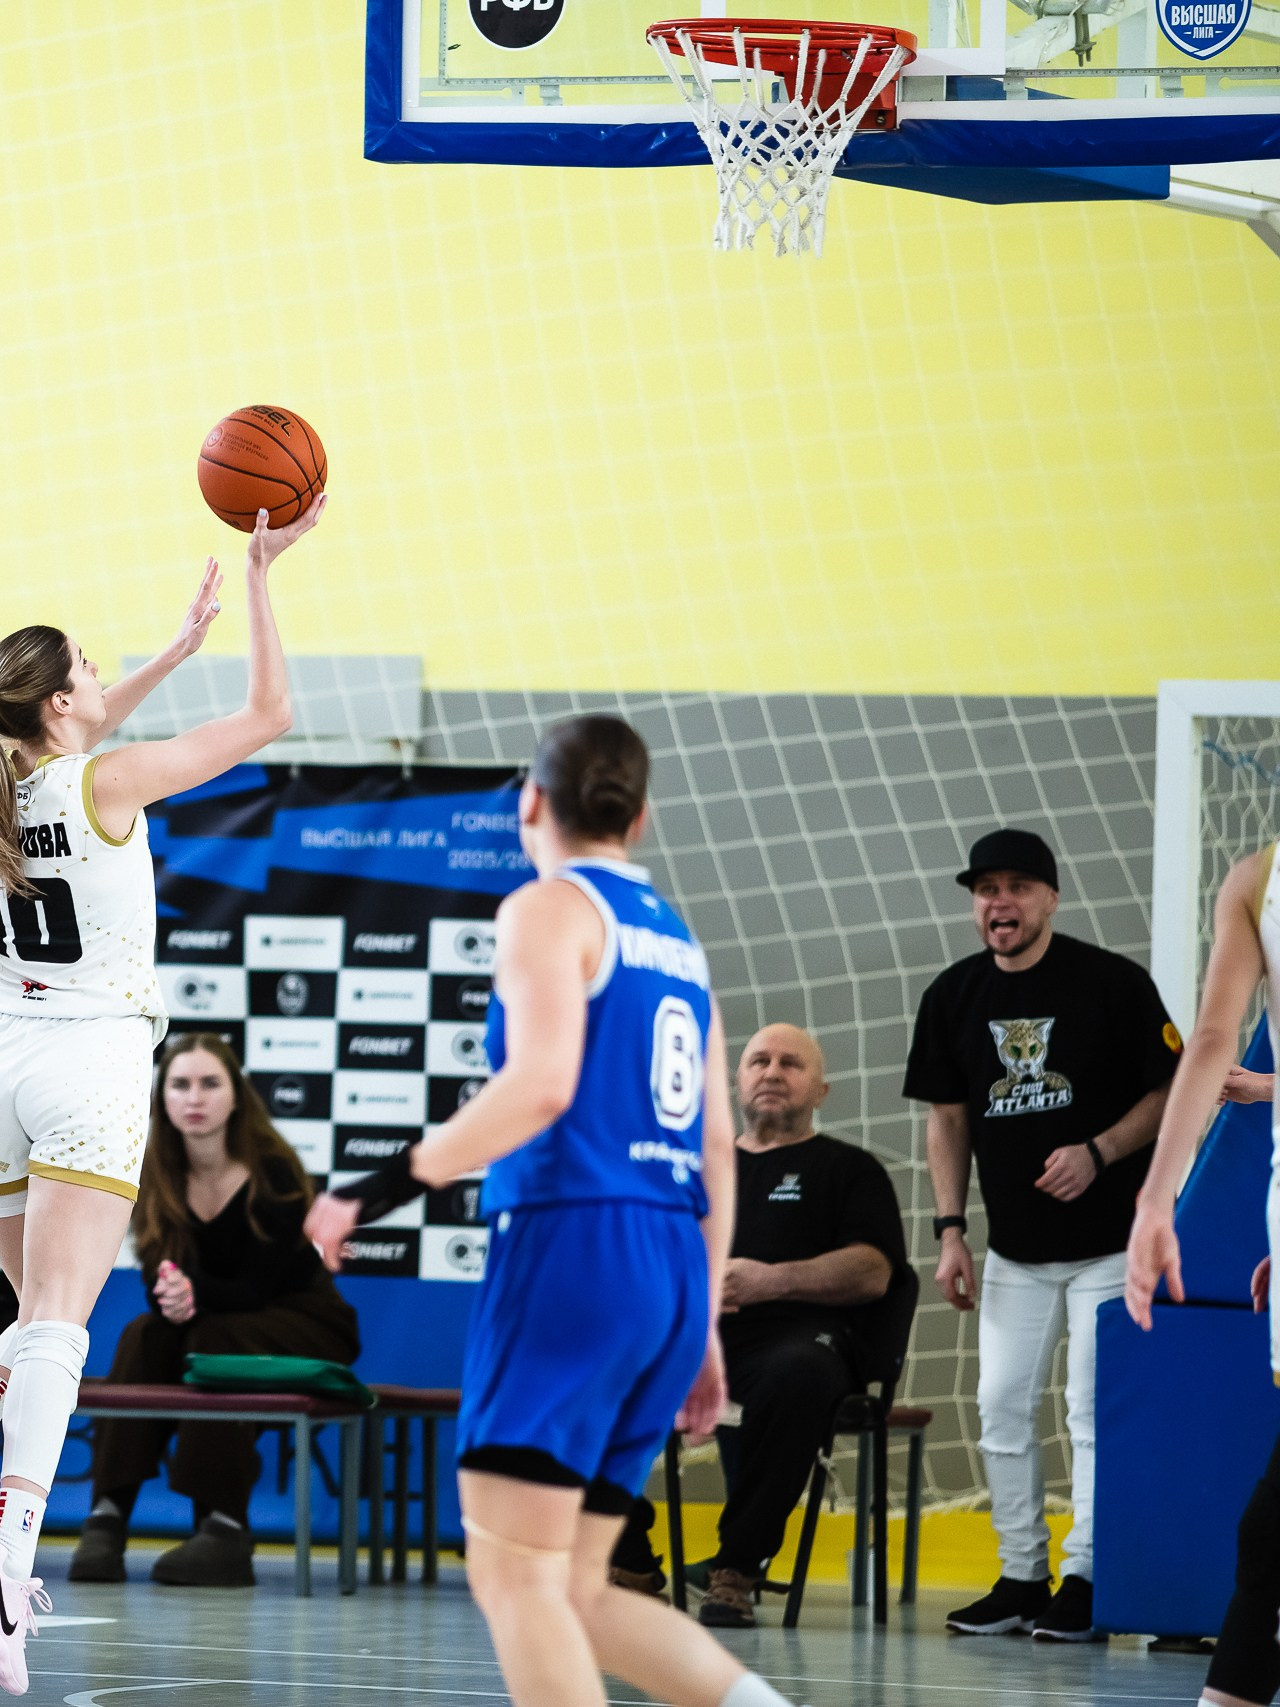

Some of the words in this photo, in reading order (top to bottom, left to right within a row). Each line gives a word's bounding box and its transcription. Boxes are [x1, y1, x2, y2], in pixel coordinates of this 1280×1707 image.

[1171, 4, 1236, 26] ВЫСШАЯ
[1192, 26, 1214, 39] ЛИГА
[451, 811, 521, 834] FONBE
[19, 822, 72, 859] ОВА
[993, 1088, 1068, 1113] ATLANTA
